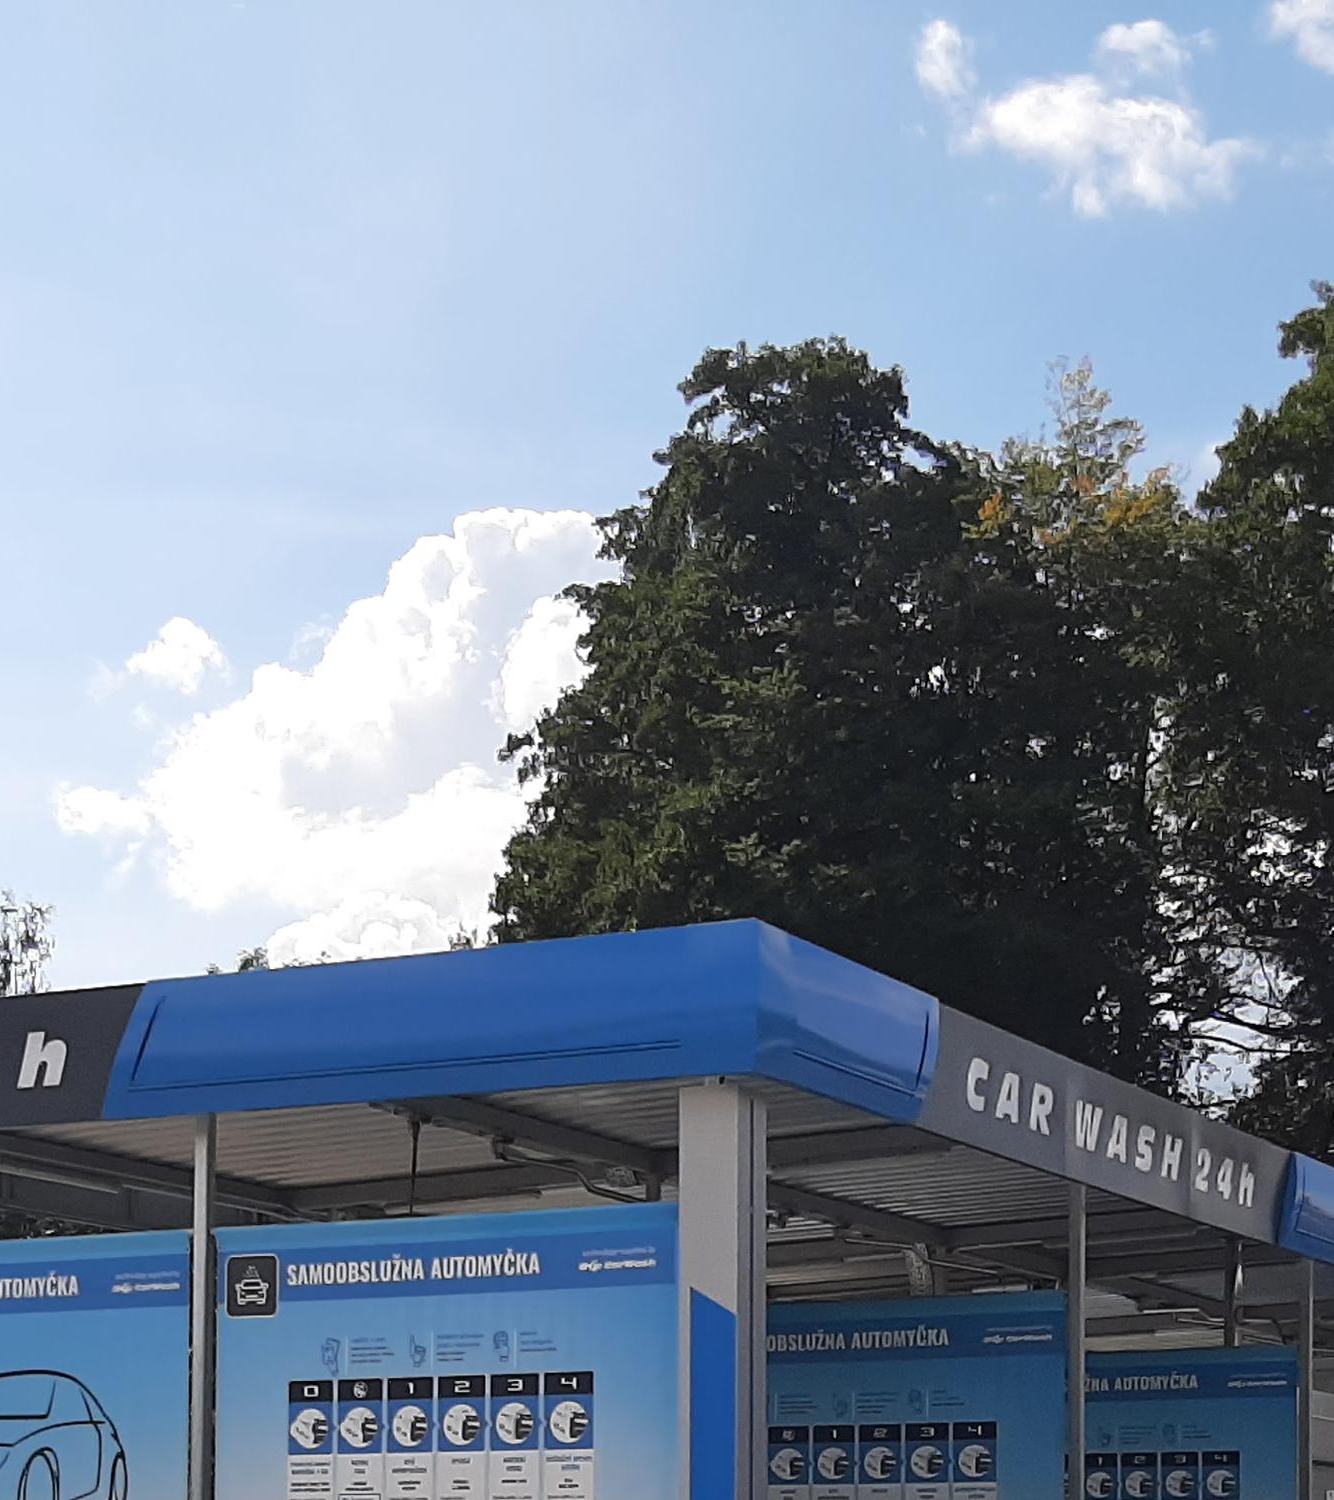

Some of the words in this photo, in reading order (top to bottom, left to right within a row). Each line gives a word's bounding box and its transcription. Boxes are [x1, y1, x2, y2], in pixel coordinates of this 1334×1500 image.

[966, 1057, 1054, 1136] CAR
[1075, 1100, 1184, 1181] WASH
[1194, 1148, 1255, 1208] 24h
[430, 1248, 541, 1280] AUTOMYČKA
[850, 1324, 950, 1350] AUTOMYČKA
[407, 1382, 415, 1395] 1
[454, 1380, 471, 1394] 2
[507, 1378, 524, 1392] 3
[561, 1376, 578, 1390] 4
